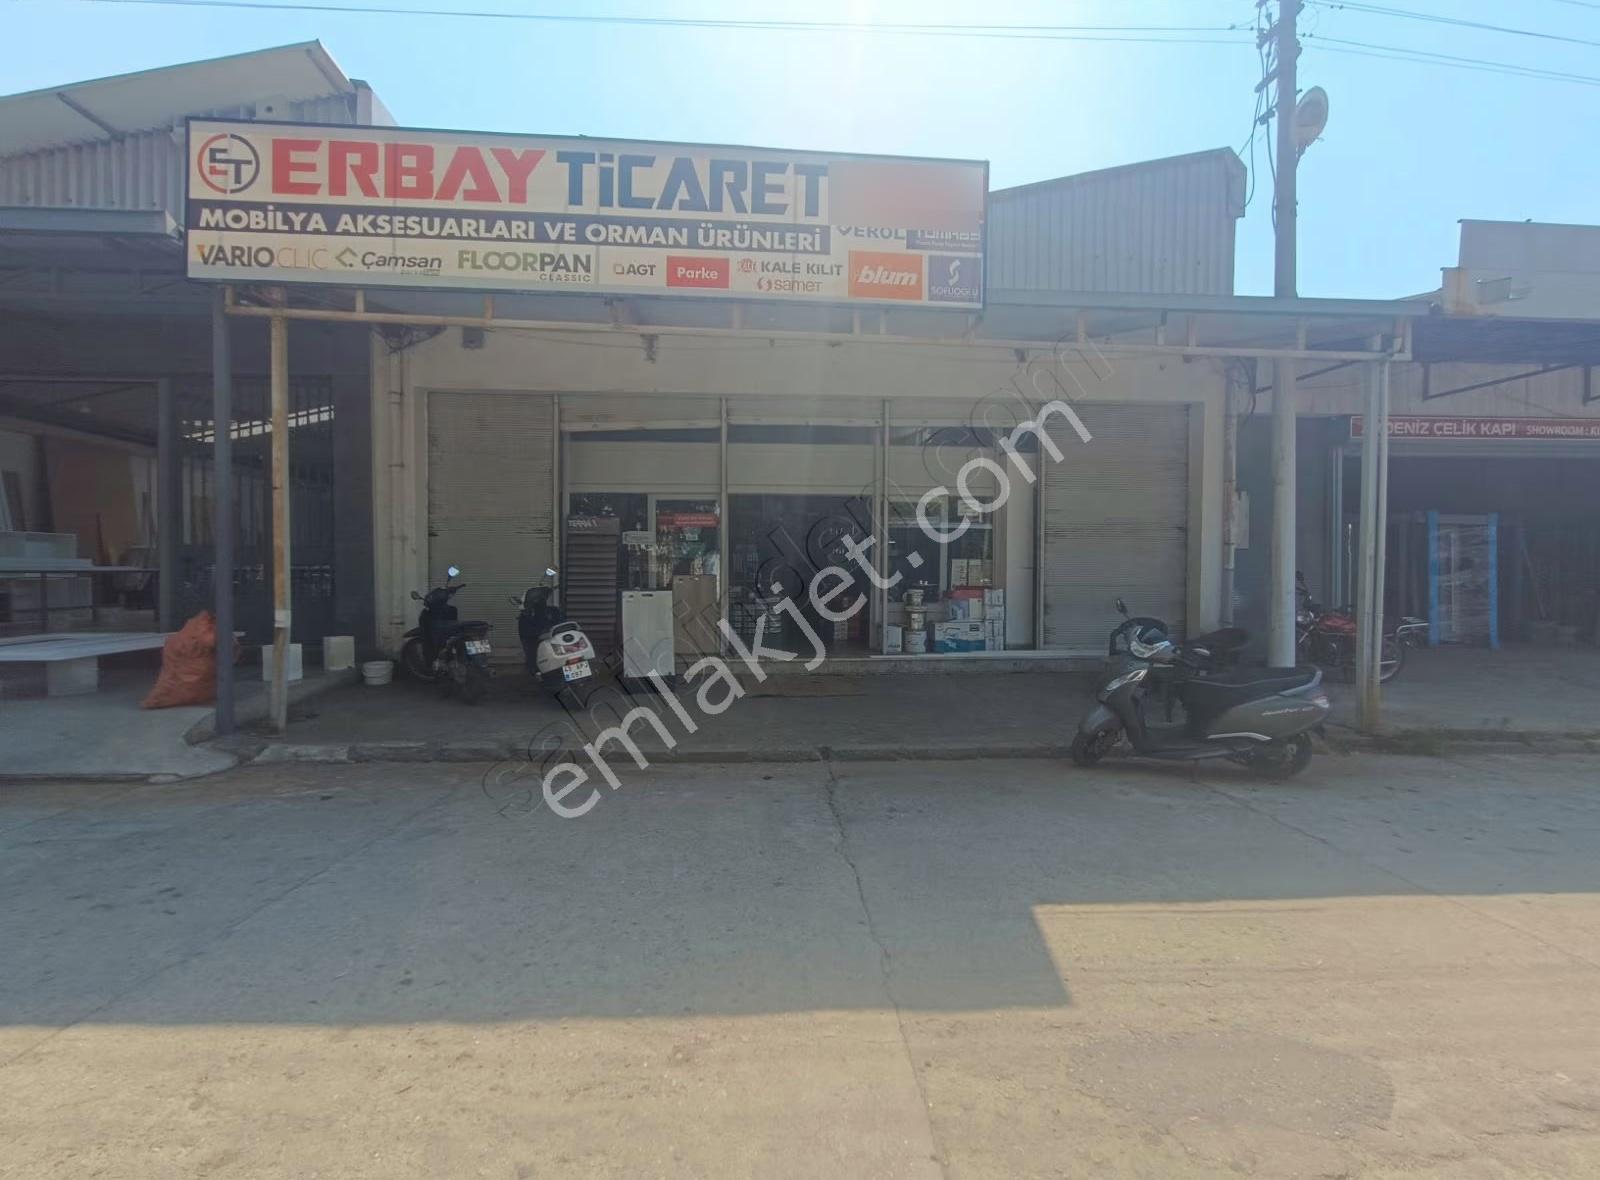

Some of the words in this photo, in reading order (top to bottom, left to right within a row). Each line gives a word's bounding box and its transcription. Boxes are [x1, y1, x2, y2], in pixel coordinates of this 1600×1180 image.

[272, 138, 547, 204] ERBAY
[556, 150, 829, 218] TİCARET
[199, 205, 327, 233] MOBİLYA
[336, 211, 535, 240] AKSESUARLARI
[543, 222, 576, 242] VE
[585, 223, 688, 247] ORMAN
[697, 223, 822, 252] ÜRÜNLERİ
[361, 251, 442, 270] Çamsan
[457, 250, 592, 273] FLOORPAN
[761, 261, 800, 275] KALE
[540, 273, 591, 283] CLASSIC
[626, 263, 657, 277] AGT
[676, 266, 719, 281] Parke
[856, 264, 919, 287] blum
[1434, 420, 1477, 437] ÇELİK
[1480, 422, 1516, 436] KAPI
